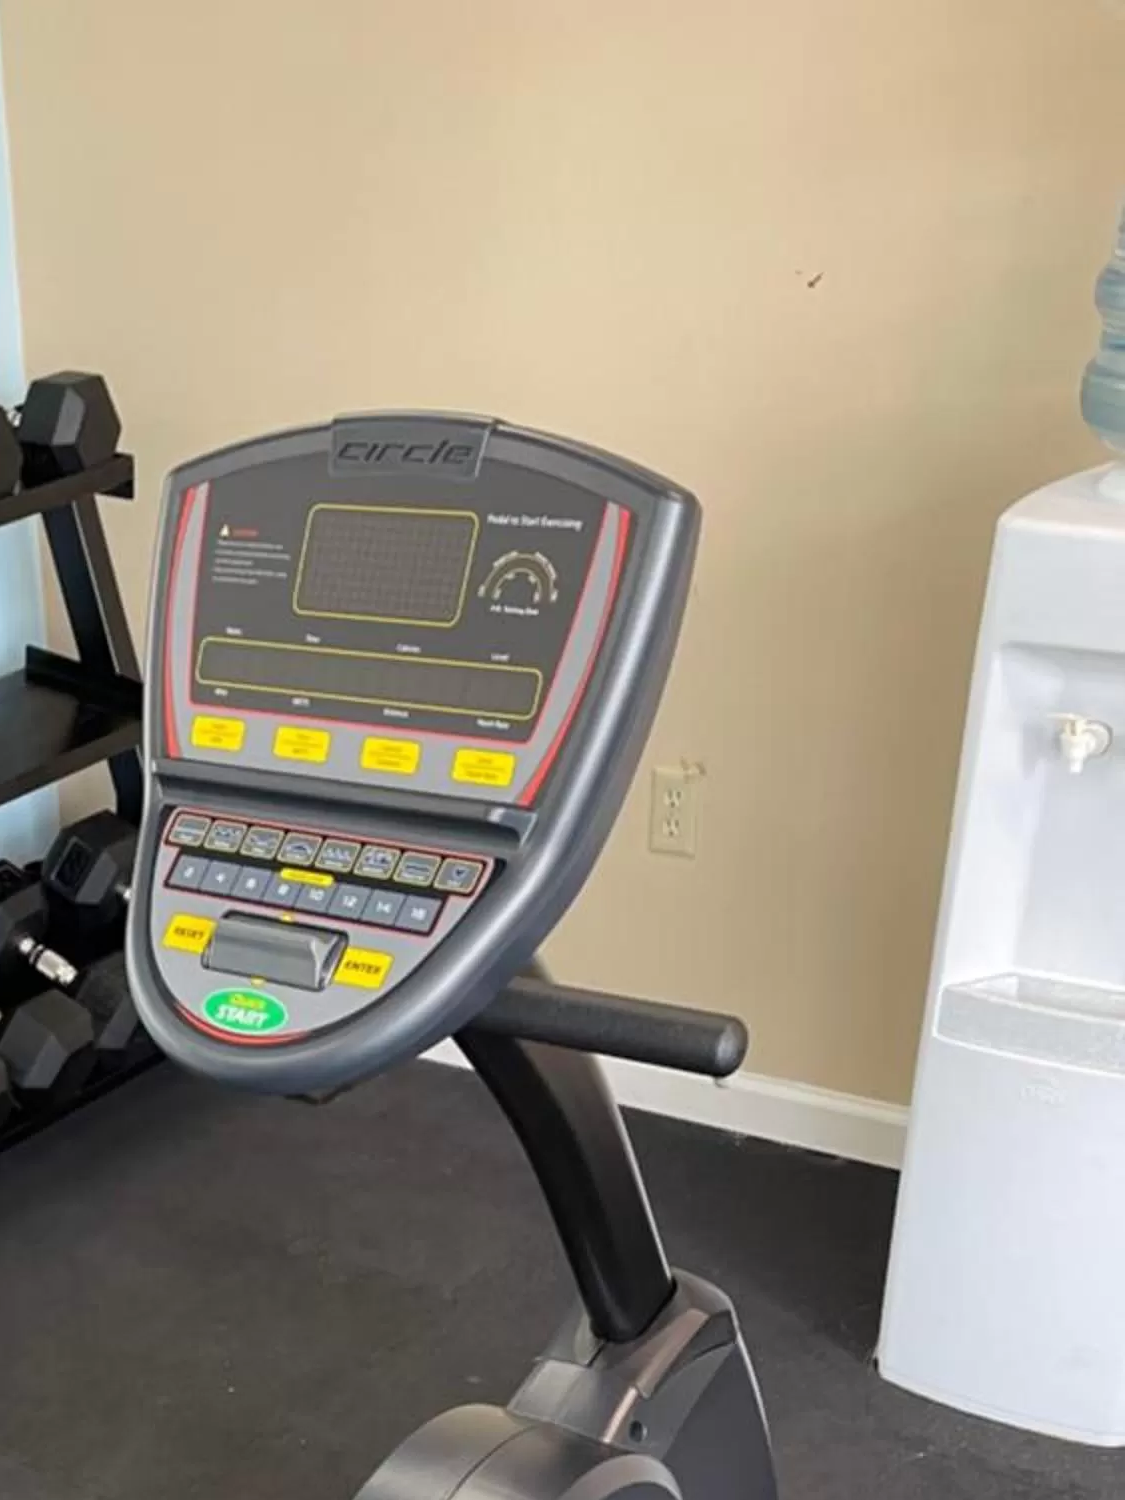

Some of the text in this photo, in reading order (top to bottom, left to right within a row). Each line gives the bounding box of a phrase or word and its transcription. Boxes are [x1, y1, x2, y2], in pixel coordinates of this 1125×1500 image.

[337, 439, 474, 465] circle
[309, 888, 325, 901] 10
[342, 895, 358, 908] 12
[376, 901, 392, 914] 14
[344, 959, 382, 975] ENTER
[215, 1004, 269, 1028] START
